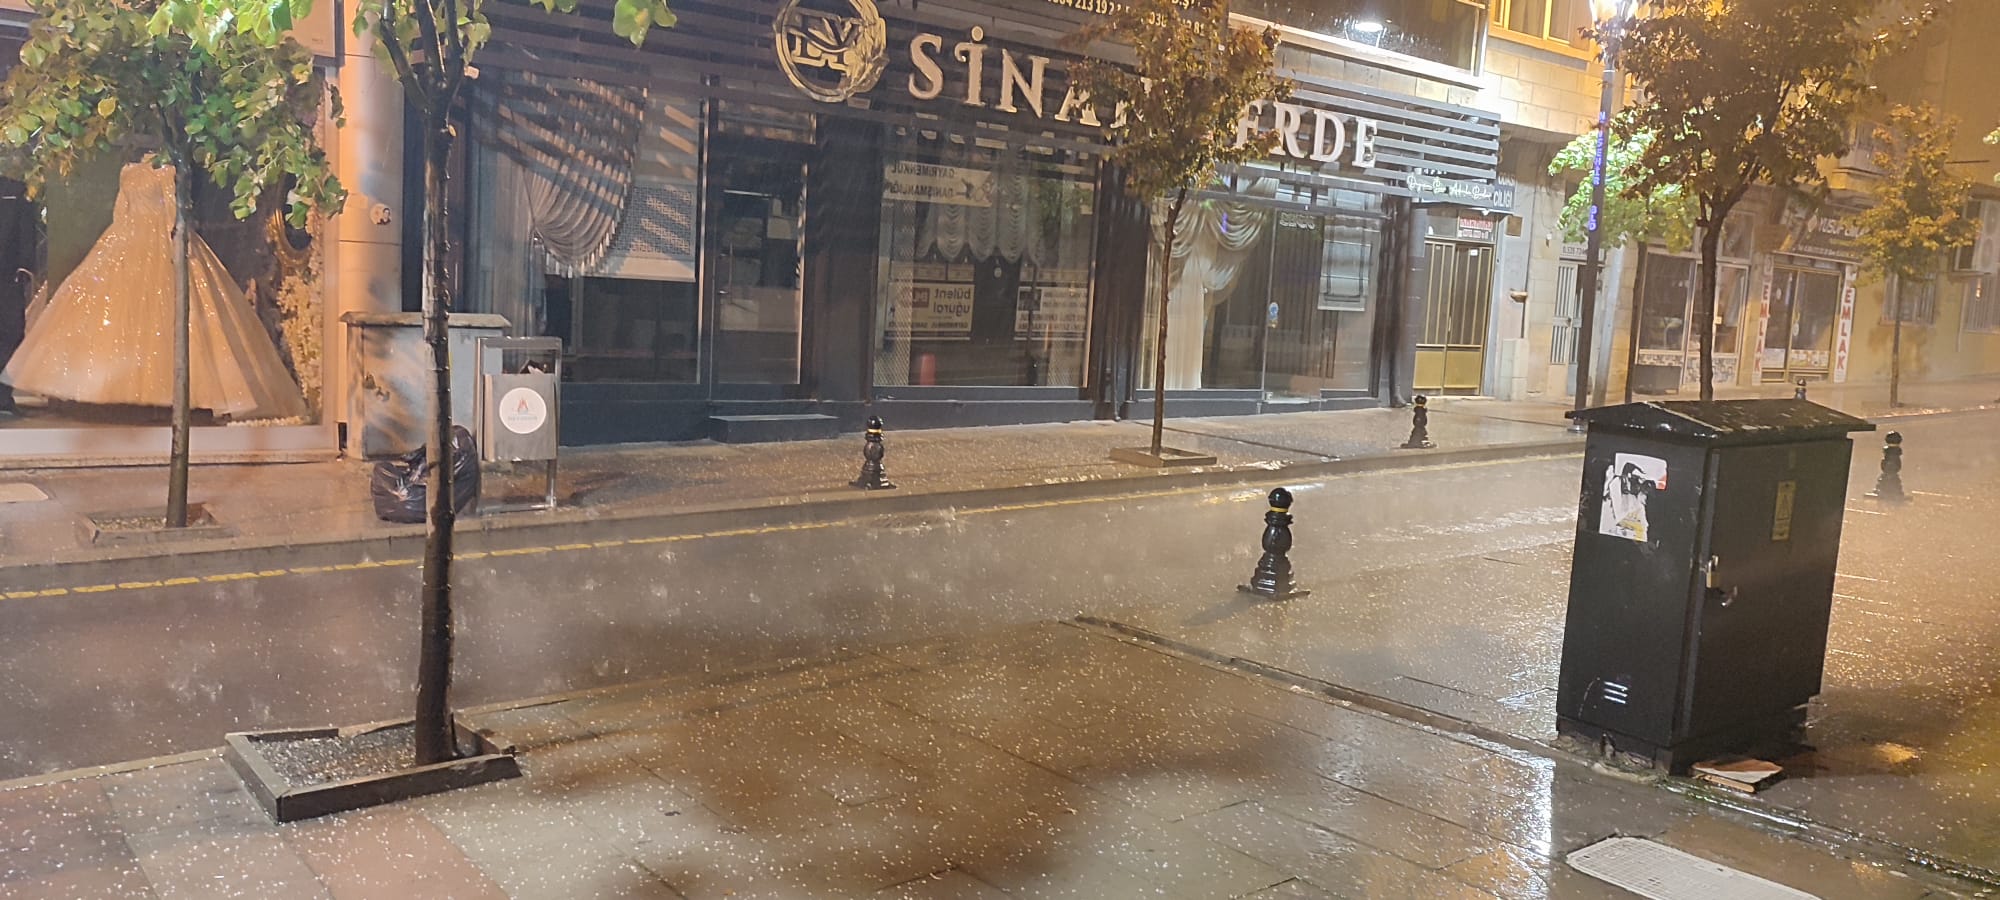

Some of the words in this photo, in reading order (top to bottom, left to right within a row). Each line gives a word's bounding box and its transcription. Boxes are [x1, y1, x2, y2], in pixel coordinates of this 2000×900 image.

[908, 25, 1152, 128] SİNA
[1235, 98, 1377, 169] ERDE
[1593, 111, 1606, 185] NVŞEHİR
[1754, 284, 1769, 372] EMLAK
[1837, 290, 1852, 370] EMLAK
